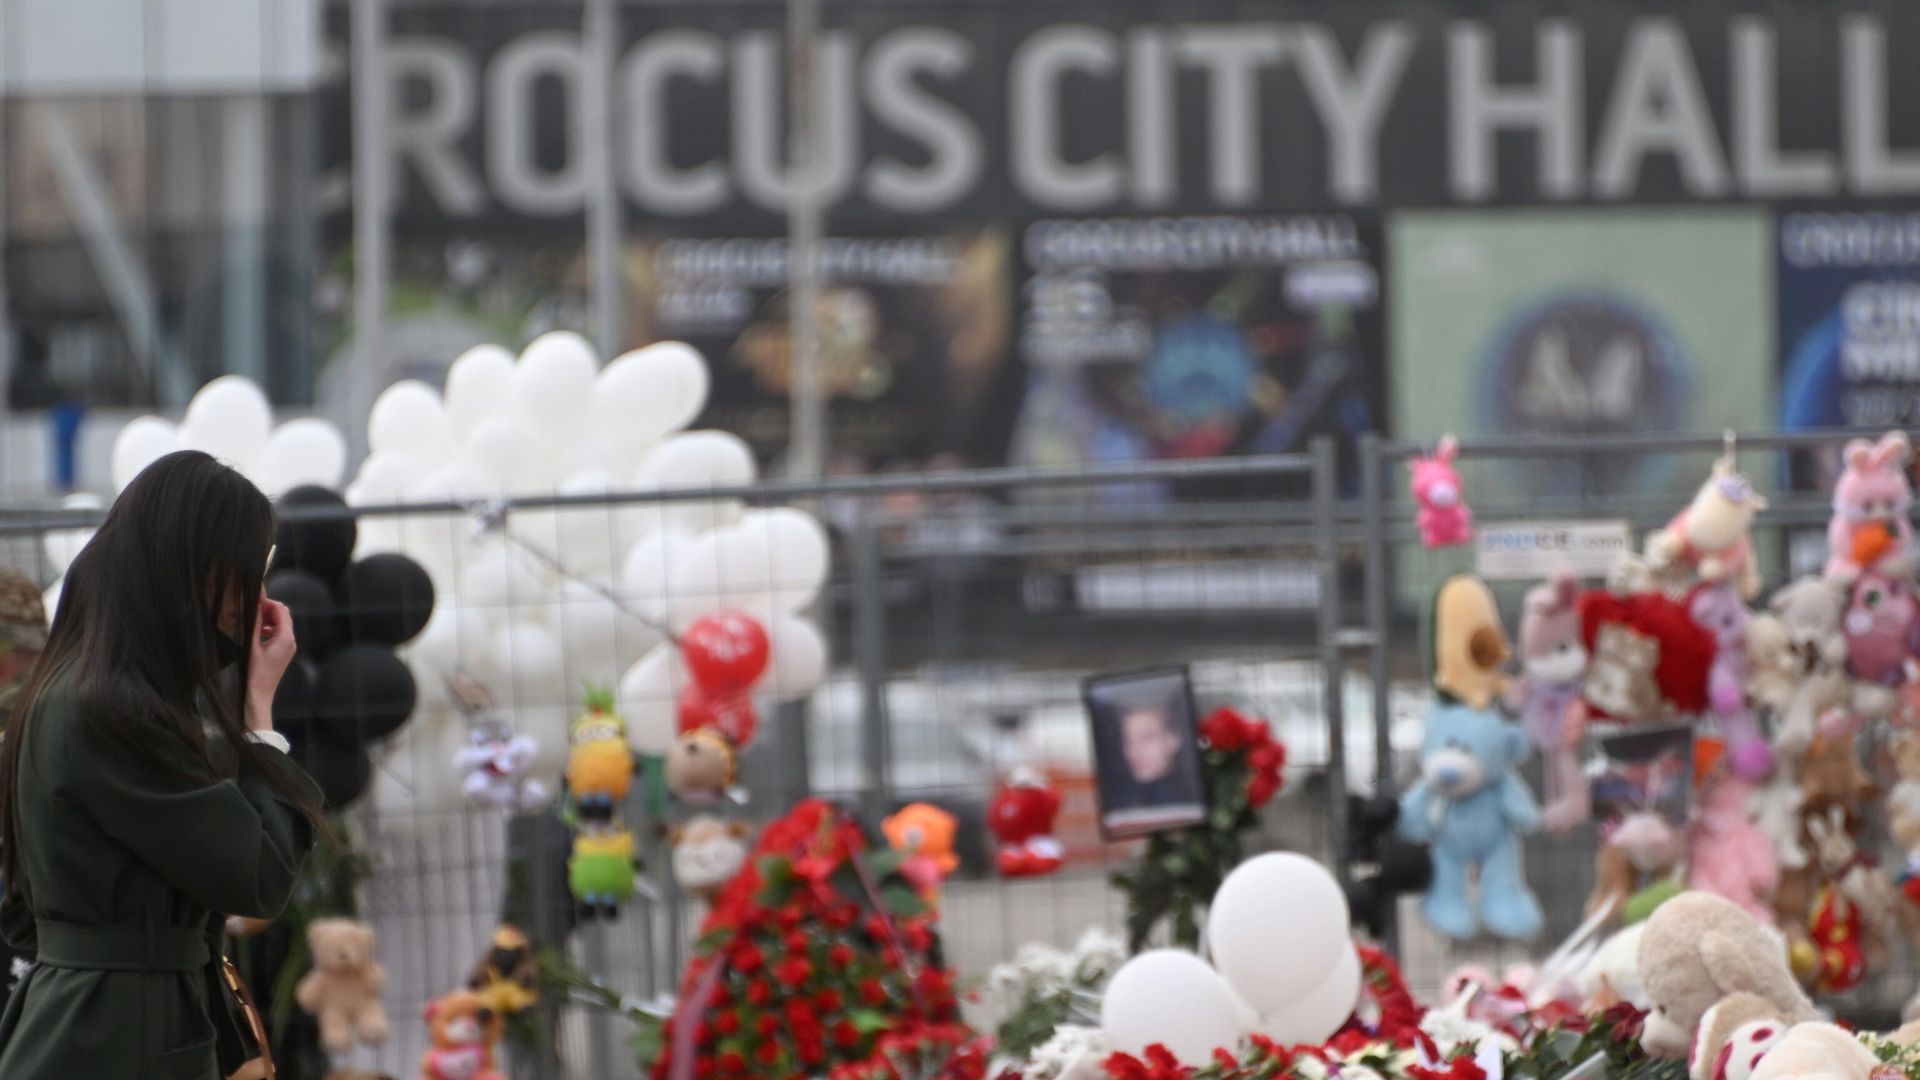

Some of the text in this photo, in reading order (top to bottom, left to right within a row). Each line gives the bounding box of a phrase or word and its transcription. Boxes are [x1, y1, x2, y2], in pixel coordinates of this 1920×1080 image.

[318, 12, 1920, 214] ROCUS CITY HALL
